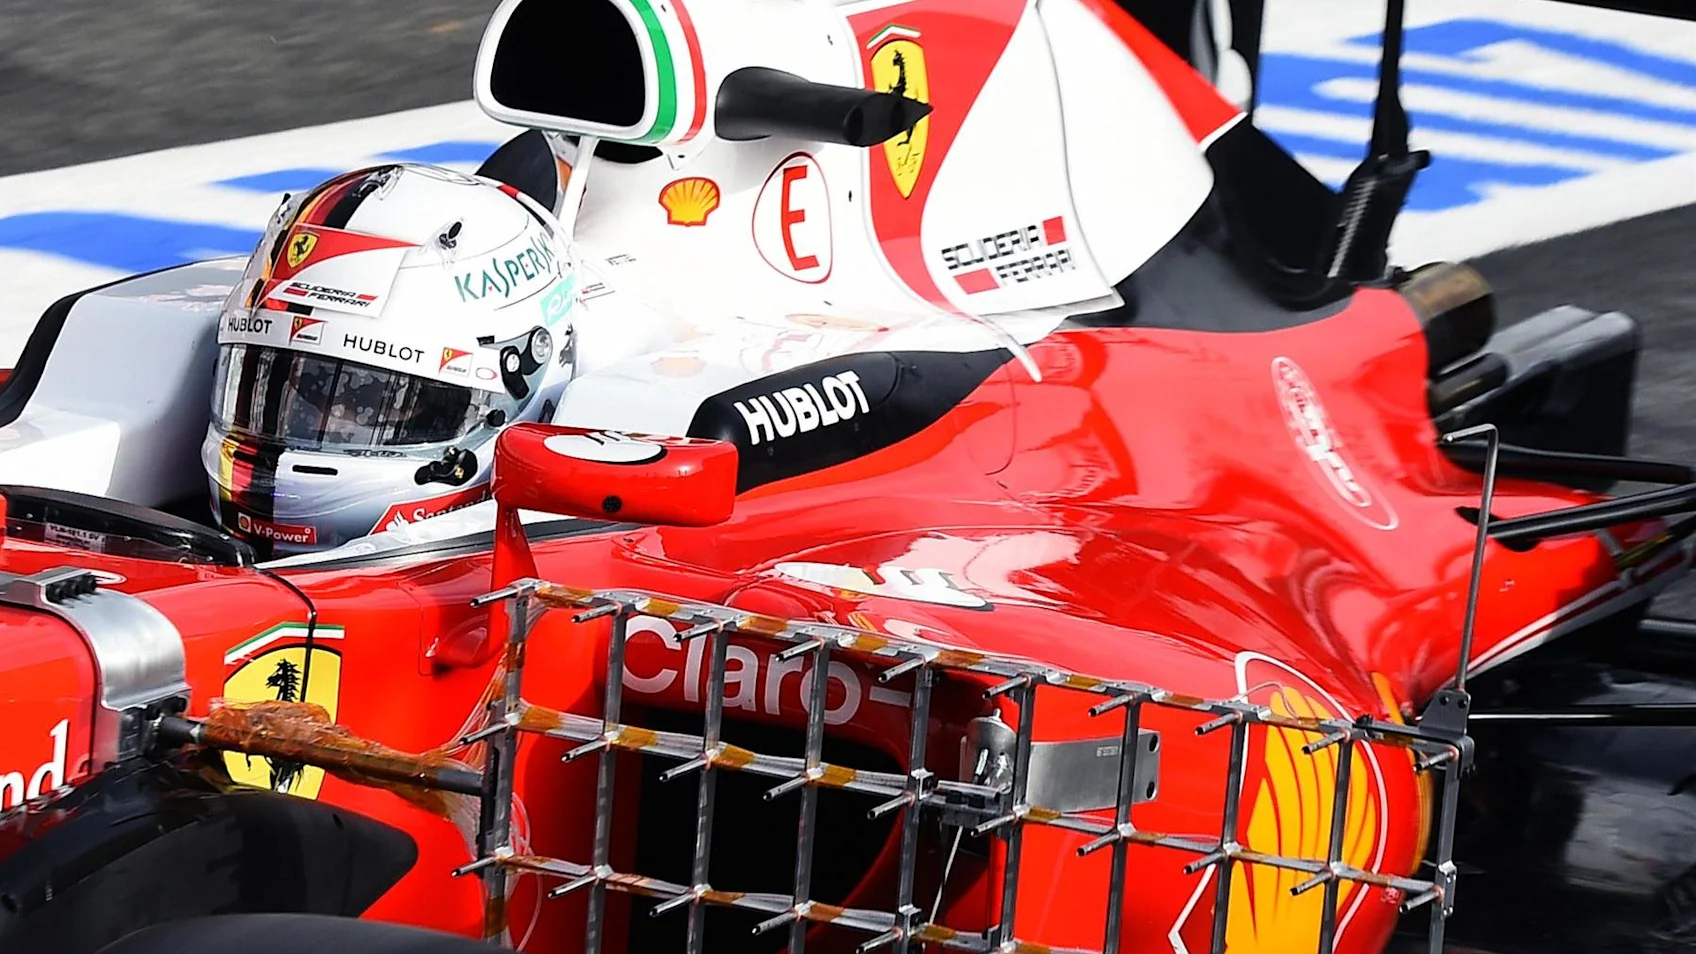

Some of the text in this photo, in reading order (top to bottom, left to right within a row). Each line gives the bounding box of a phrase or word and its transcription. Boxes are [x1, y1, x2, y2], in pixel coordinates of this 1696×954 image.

[780, 165, 819, 271] E
[454, 232, 556, 302] KASPERSK
[290, 282, 356, 298] SCUDERIA
[307, 292, 372, 307] FERRARI
[228, 315, 273, 334] HUBLOT
[343, 333, 425, 363] HUBLOT
[734, 370, 870, 444] HUBLOT
[253, 526, 309, 543] V-Power
